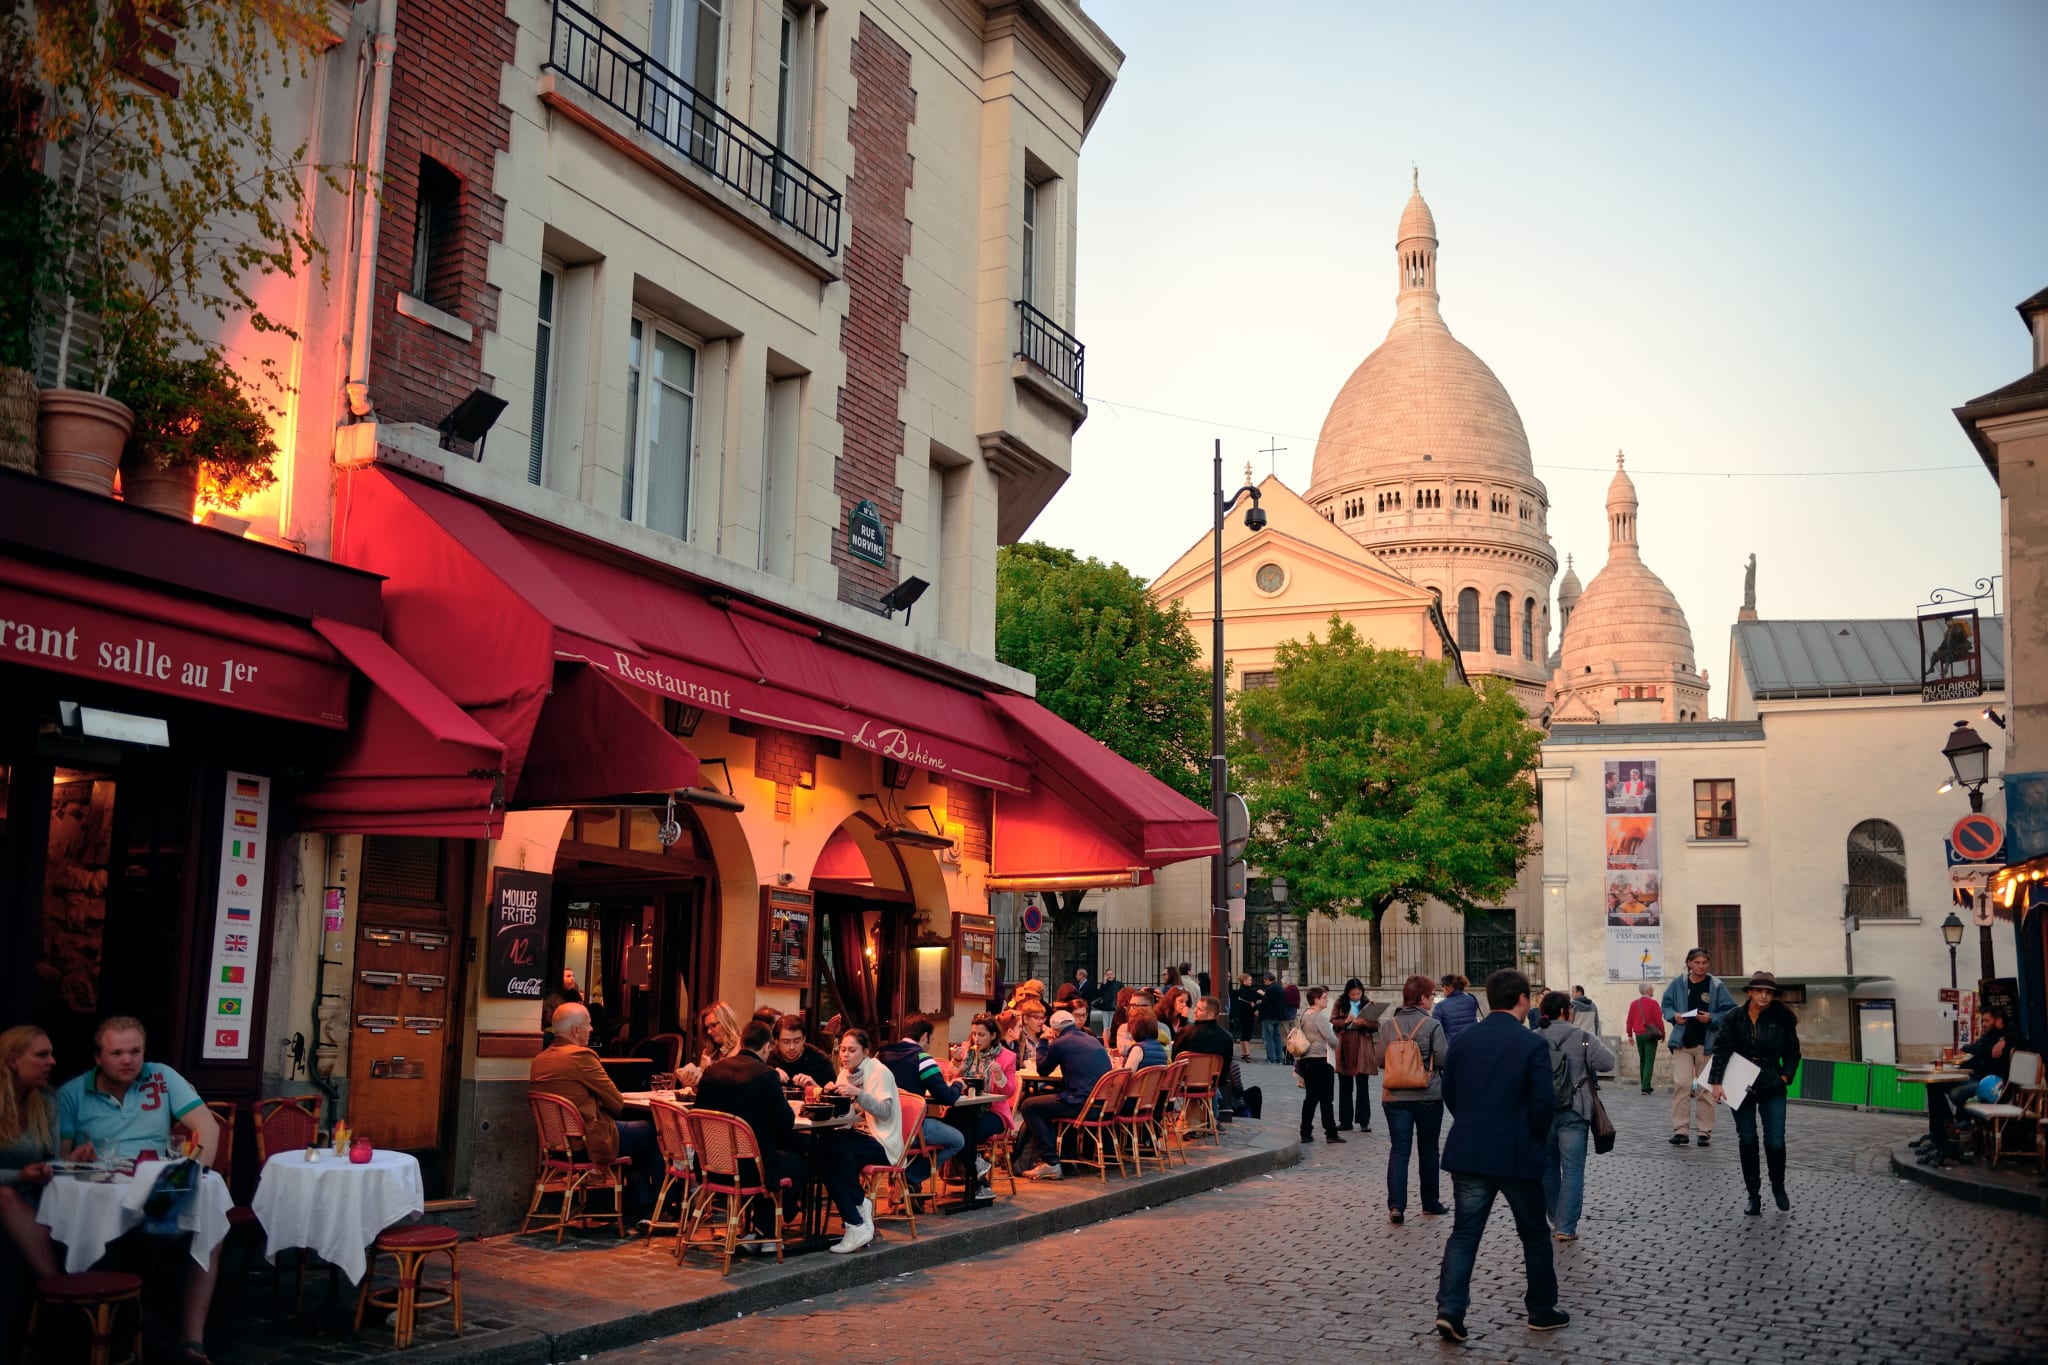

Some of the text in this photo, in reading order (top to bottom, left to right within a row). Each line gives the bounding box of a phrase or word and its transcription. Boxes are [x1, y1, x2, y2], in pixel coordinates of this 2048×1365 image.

[852, 534, 883, 557] NORVINS
[861, 525, 876, 540] RUE
[98, 639, 172, 680] salle
[181, 661, 209, 688] au
[219, 659, 258, 693] 1er
[614, 651, 731, 709] Restaurant
[1923, 680, 1980, 695] AU CLAIRON
[852, 720, 947, 769] La Bohème
[502, 889, 538, 908] MOULES
[138, 1081, 161, 1111] 3
